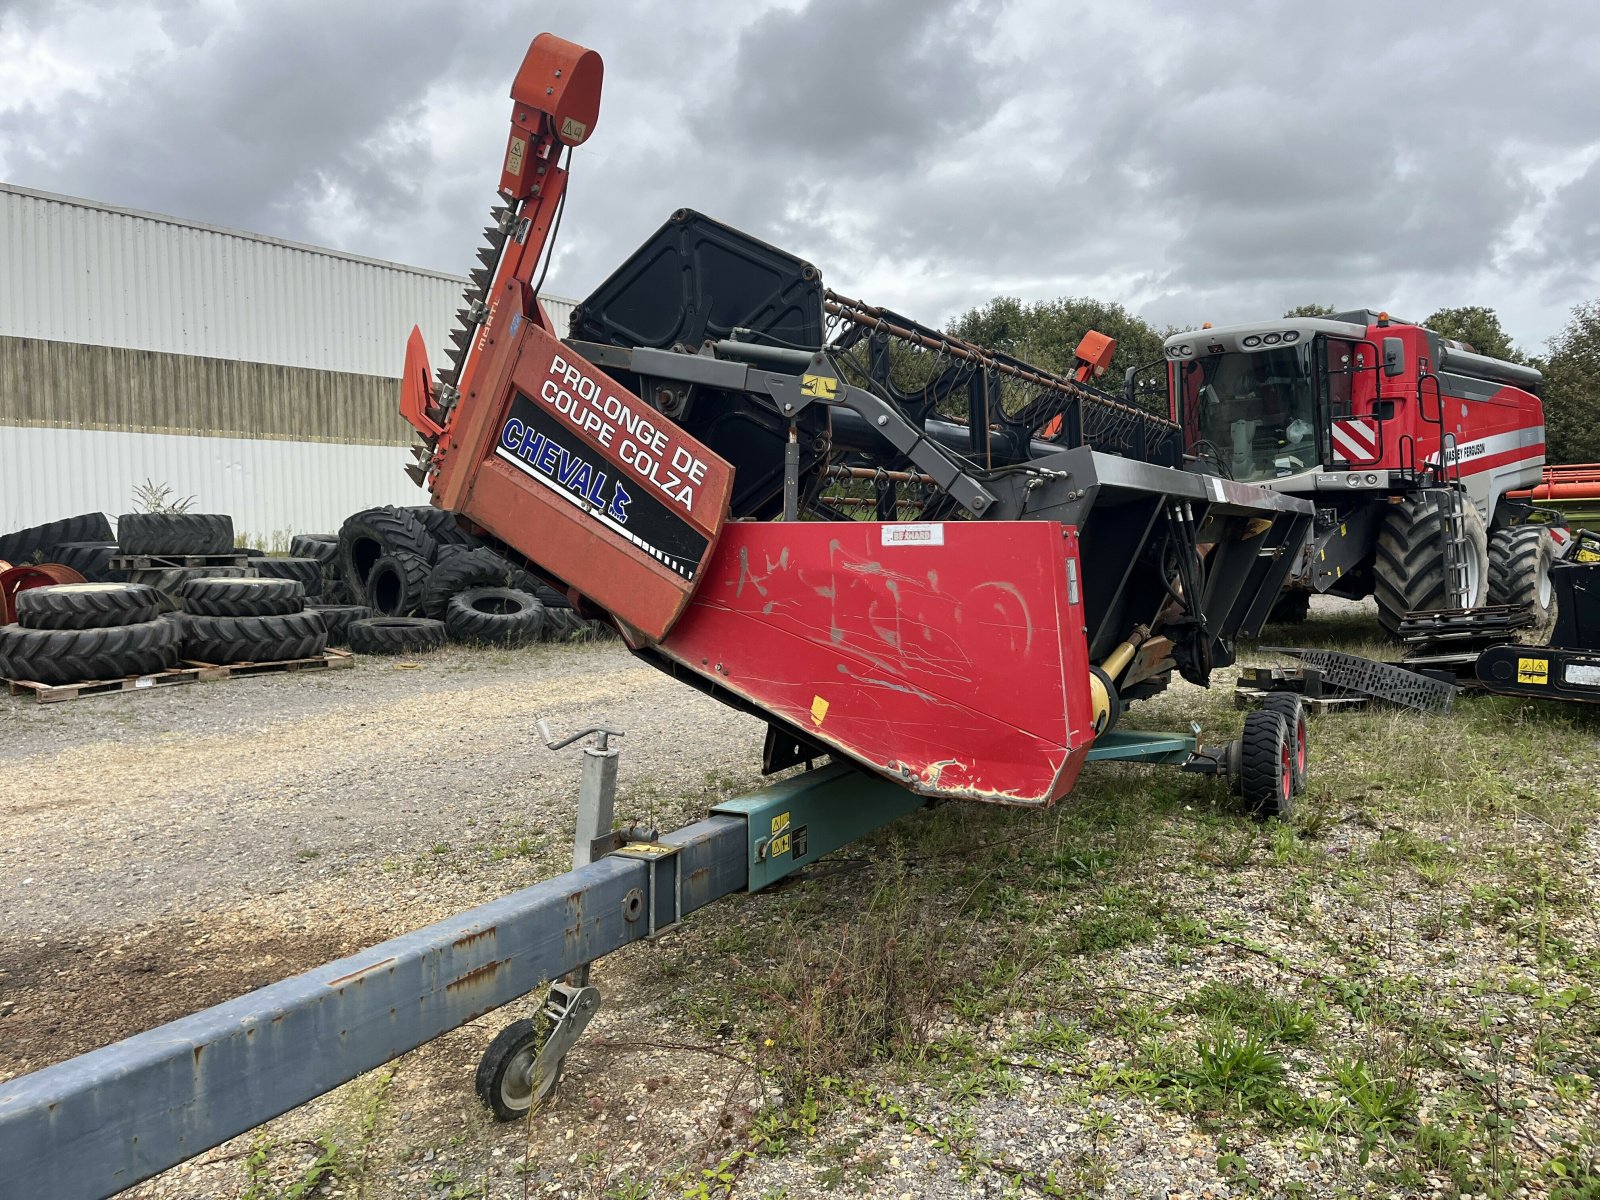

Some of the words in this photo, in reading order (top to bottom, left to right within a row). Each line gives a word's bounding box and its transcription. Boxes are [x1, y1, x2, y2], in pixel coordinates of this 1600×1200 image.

[501, 418, 607, 508] CHEVAL
[540, 380, 616, 448] COUPE
[619, 440, 693, 512] COLZA
[549, 354, 669, 457] PROLONGE
[671, 446, 708, 485] DE
[1464, 443, 1486, 458] FERGUSON
